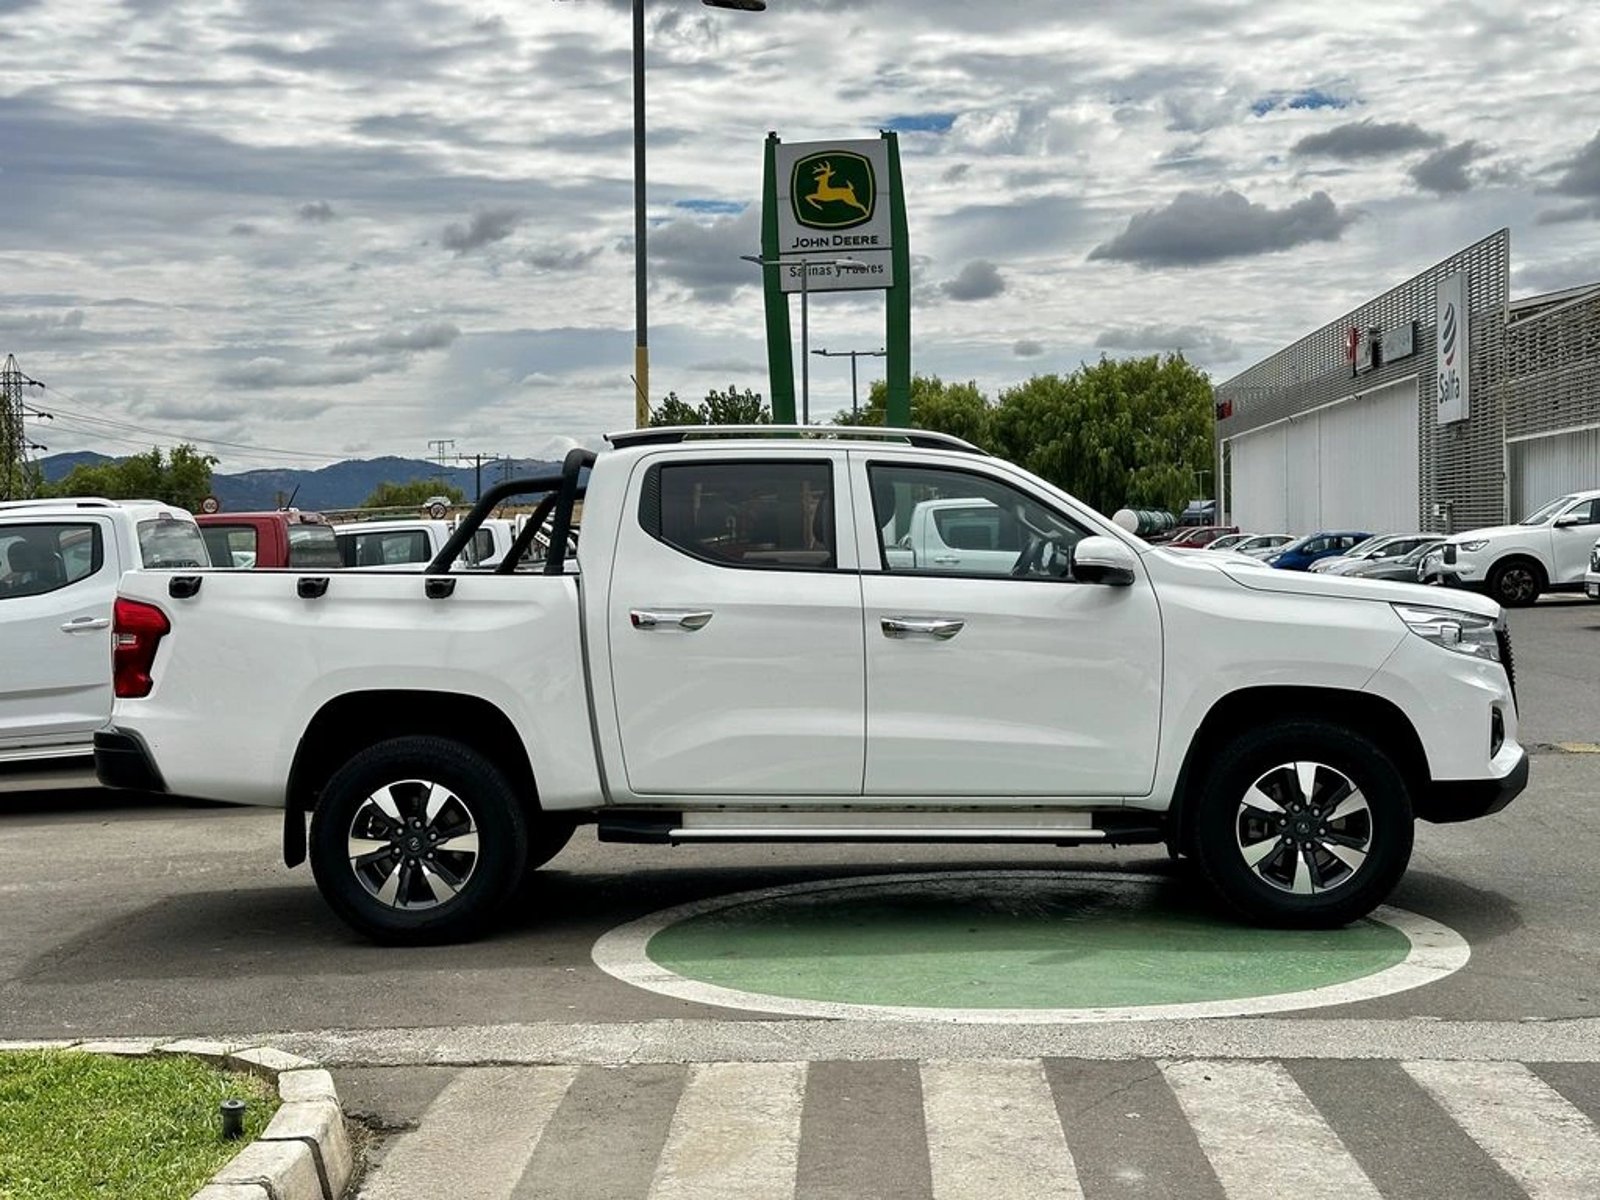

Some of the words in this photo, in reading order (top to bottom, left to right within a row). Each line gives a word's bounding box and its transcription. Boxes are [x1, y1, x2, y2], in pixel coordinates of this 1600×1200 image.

[792, 237, 829, 248] JOHN
[832, 235, 879, 246] DEERE
[790, 265, 832, 278] Sainas
[1438, 368, 1460, 404] Salfa
